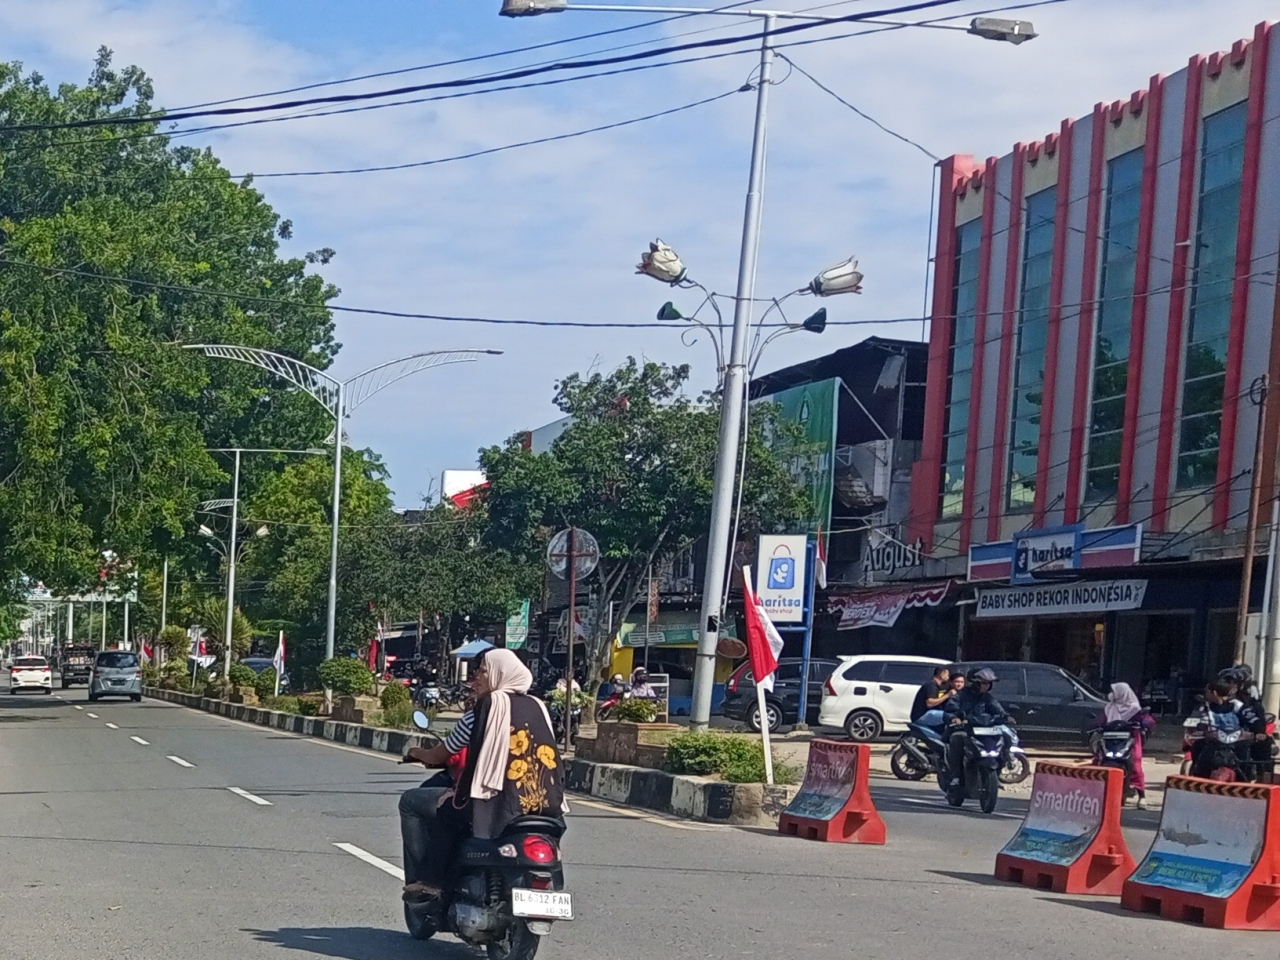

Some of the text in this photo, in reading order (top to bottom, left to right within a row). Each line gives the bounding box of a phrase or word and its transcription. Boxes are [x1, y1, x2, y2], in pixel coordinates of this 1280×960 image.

[862, 537, 922, 576] August
[981, 585, 1132, 609] BABY SHOP REKOR INDONESIA
[1034, 789, 1100, 816] smartfren
[552, 895, 570, 906] FAN
